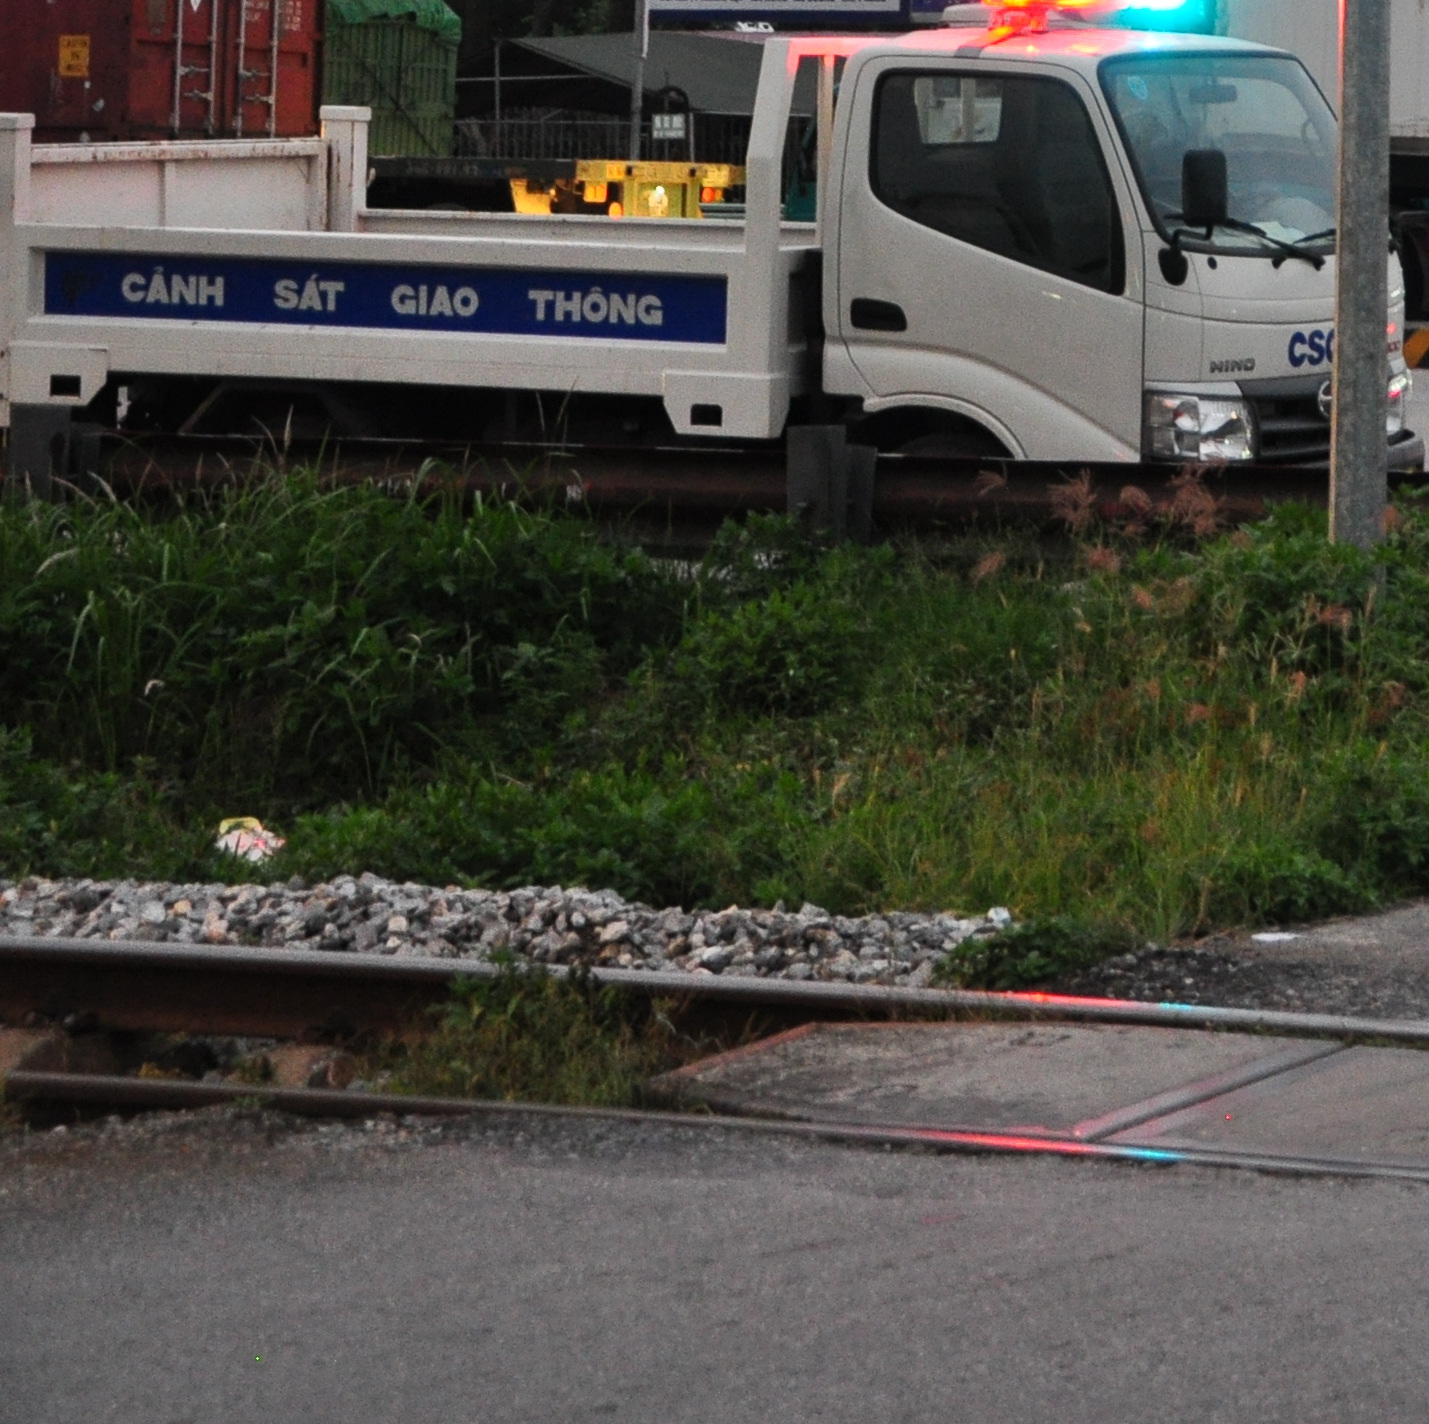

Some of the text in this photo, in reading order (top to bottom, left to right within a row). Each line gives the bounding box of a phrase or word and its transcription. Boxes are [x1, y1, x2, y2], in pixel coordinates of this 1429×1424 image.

[121, 266, 664, 327] CẢNH SÁT GIAO THÔNG
[1209, 358, 1256, 374] HINO
[1287, 329, 1338, 368] CS
